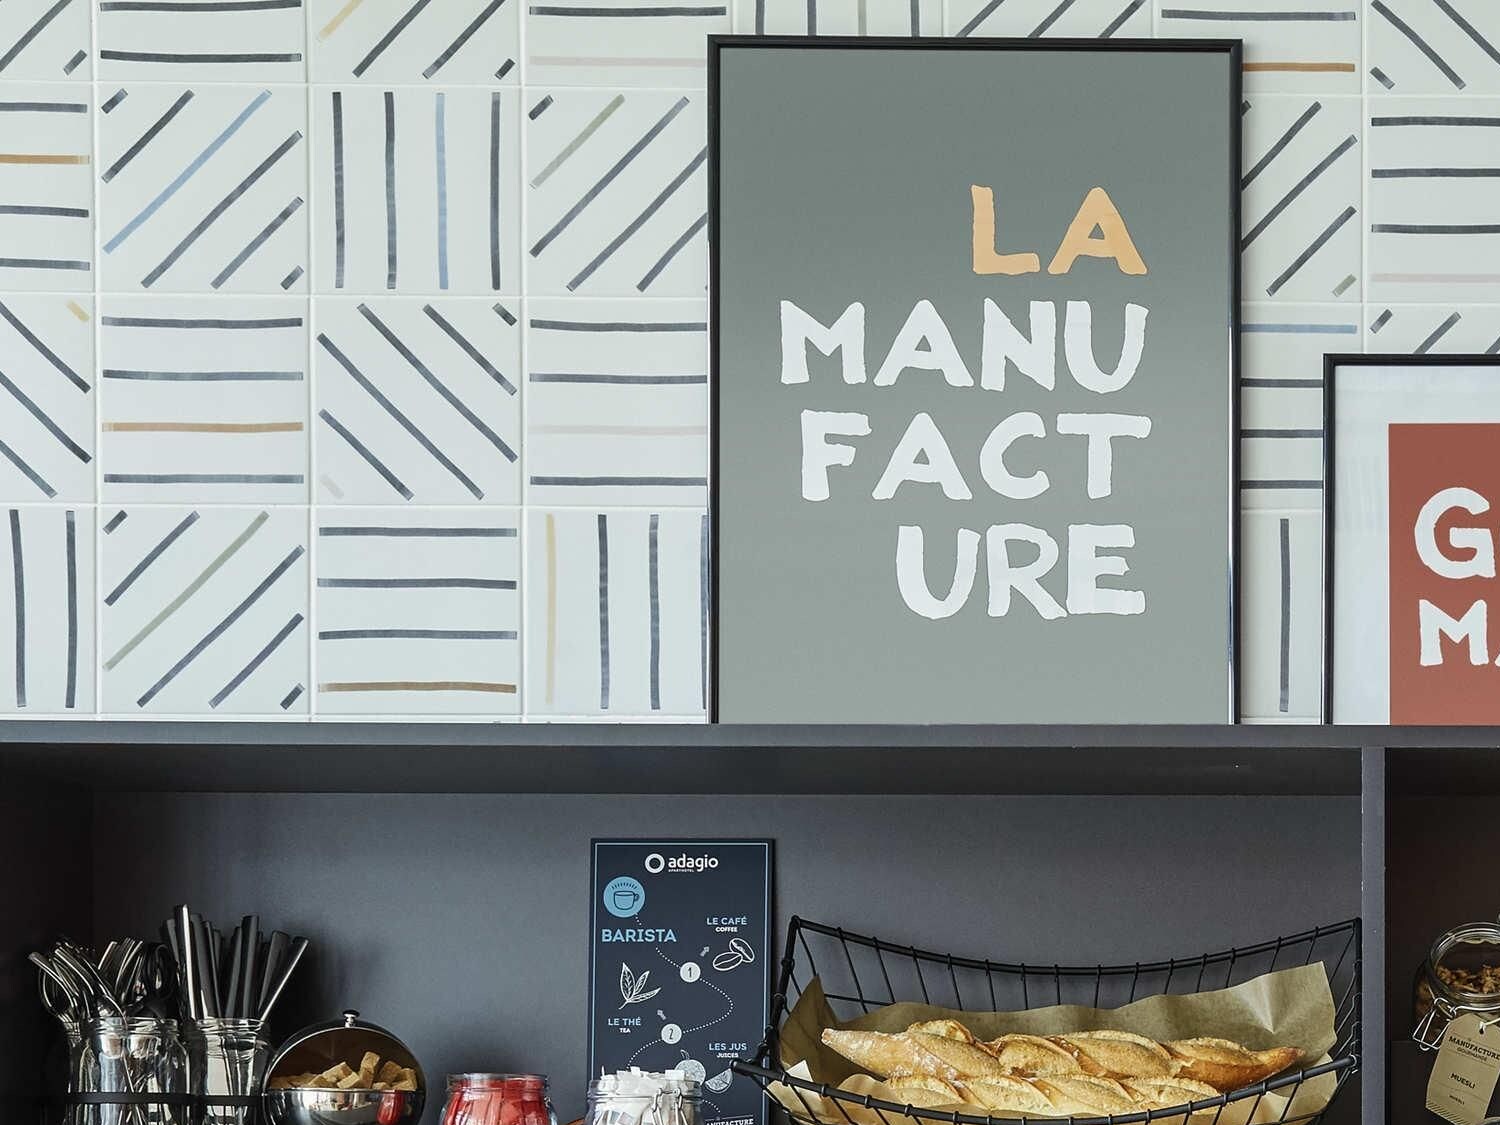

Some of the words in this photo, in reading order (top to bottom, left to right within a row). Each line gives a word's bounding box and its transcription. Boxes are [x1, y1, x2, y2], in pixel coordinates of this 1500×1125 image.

[970, 185, 1147, 276] LA
[780, 298, 1148, 394] MANU
[799, 410, 1151, 501] FACT
[896, 523, 1147, 620] URE
[668, 853, 719, 872] adagio
[706, 917, 719, 925] LE
[720, 916, 748, 925] CAFÉ
[601, 928, 677, 942] BARISTA
[607, 1018, 620, 1026] LE
[622, 1016, 642, 1026] THÉ
[708, 1043, 726, 1051] LES
[729, 1043, 748, 1051] JUS
[1448, 1036, 1500, 1061] MANUFACTURE
[1450, 1072, 1476, 1089] MUESLI
